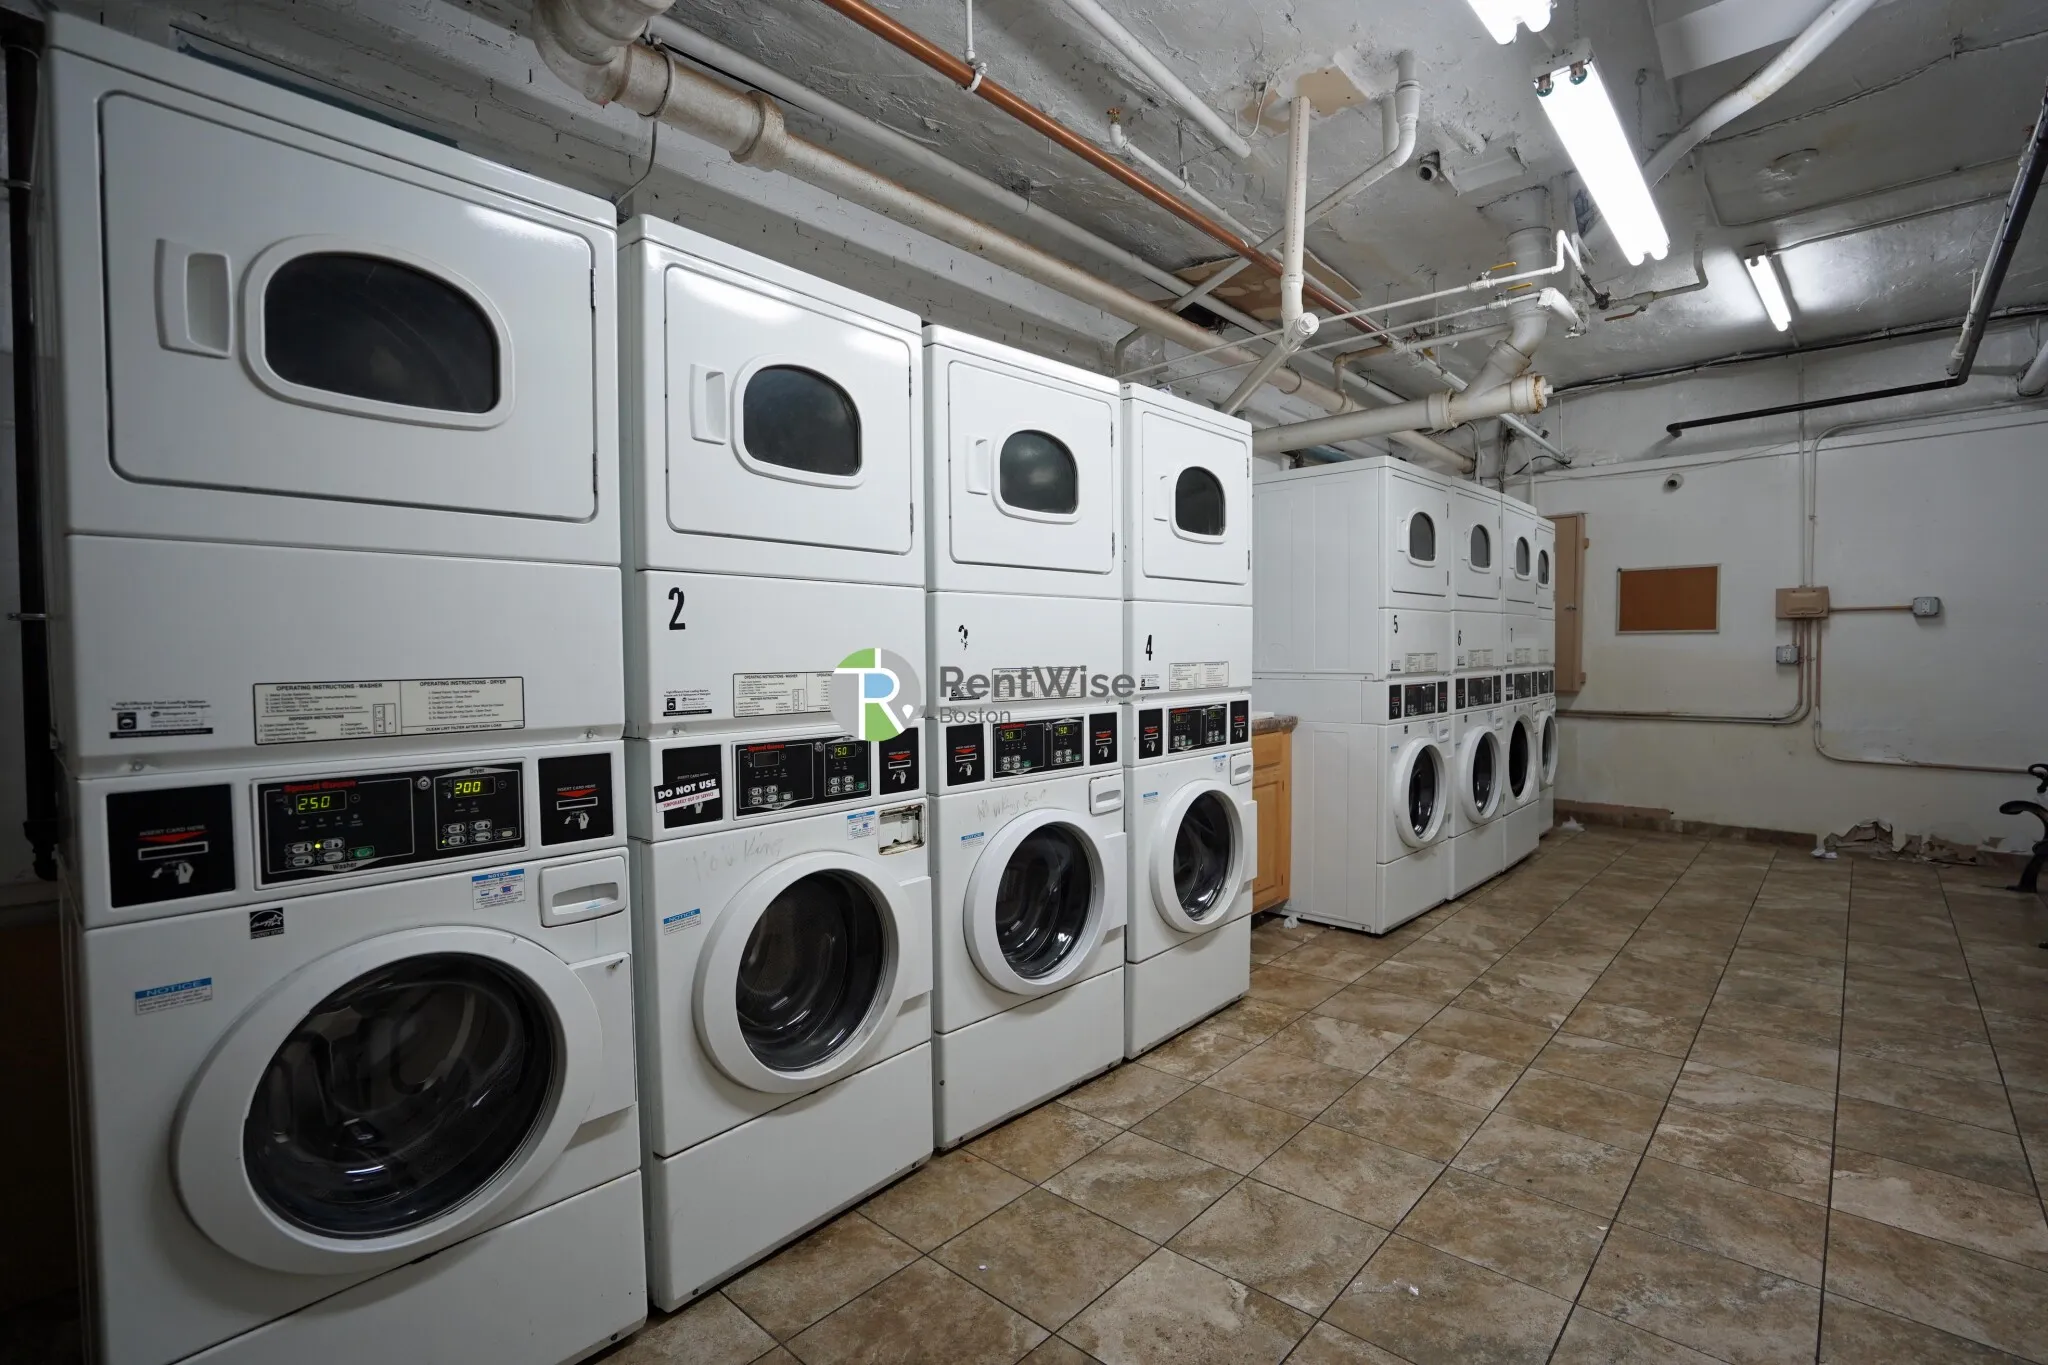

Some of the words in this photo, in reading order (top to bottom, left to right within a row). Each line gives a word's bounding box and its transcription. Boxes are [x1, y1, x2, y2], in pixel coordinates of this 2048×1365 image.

[668, 587, 686, 631] 2
[1393, 614, 1399, 634] 5
[1457, 629, 1462, 646] 6
[1145, 634, 1153, 661] 4
[312, 683, 355, 691] INSTRUCTIONS
[284, 782, 320, 792] Speed
[321, 780, 357, 790] Queen
[455, 781, 481, 794] 200
[658, 788, 673, 800] DO
[676, 783, 697, 796] NOT
[698, 778, 717, 790] USE
[298, 795, 331, 811] 250
[663, 799, 687, 808] TEMPORARILY
[140, 828, 165, 837] INSERT
[166, 827, 186, 835] CARD
[332, 861, 358, 871] Washer
[487, 871, 510, 879] NOTICE
[669, 911, 694, 922] NOTICE
[146, 981, 202, 997] NOTICE
